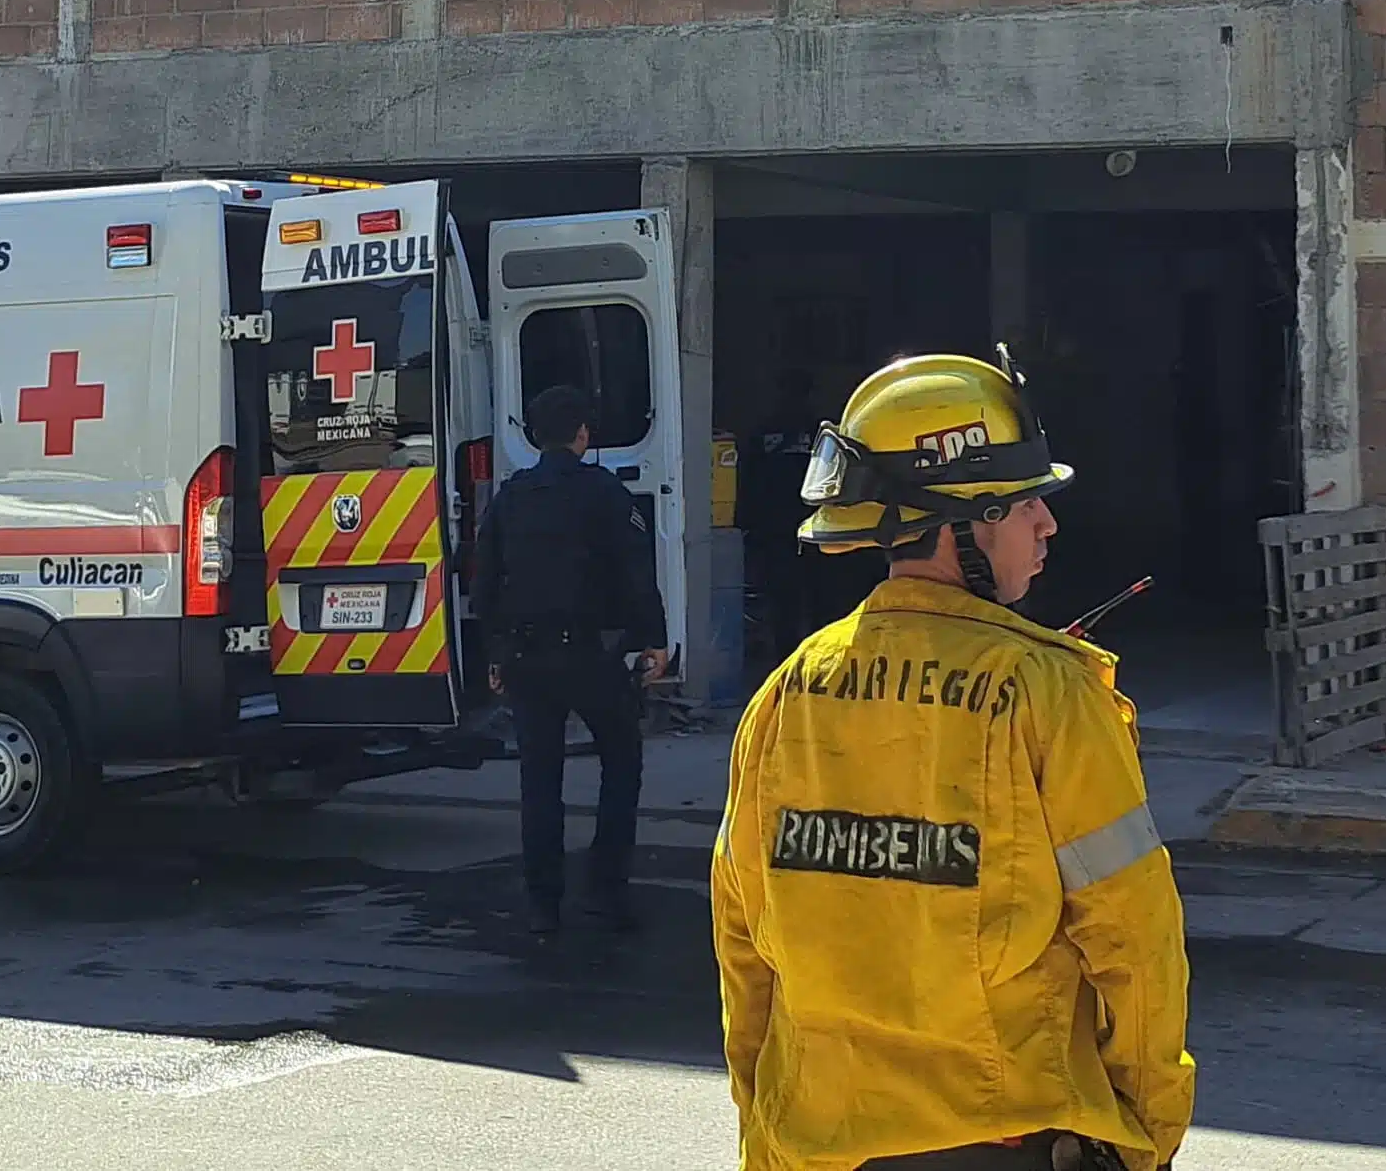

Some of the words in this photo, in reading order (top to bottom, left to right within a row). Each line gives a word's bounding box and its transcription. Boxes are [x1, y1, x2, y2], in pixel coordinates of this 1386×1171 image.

[302, 235, 435, 283] AMBUL
[317, 416, 342, 427] CRUZ
[346, 414, 370, 427] ROJA
[317, 427, 371, 441] MEXICANA
[38, 556, 143, 585] Culiacan
[341, 591, 361, 599] CRUZ
[362, 590, 381, 598] ROJA
[340, 601, 380, 609] MEXICANA
[332, 611, 373, 624] SIN-233
